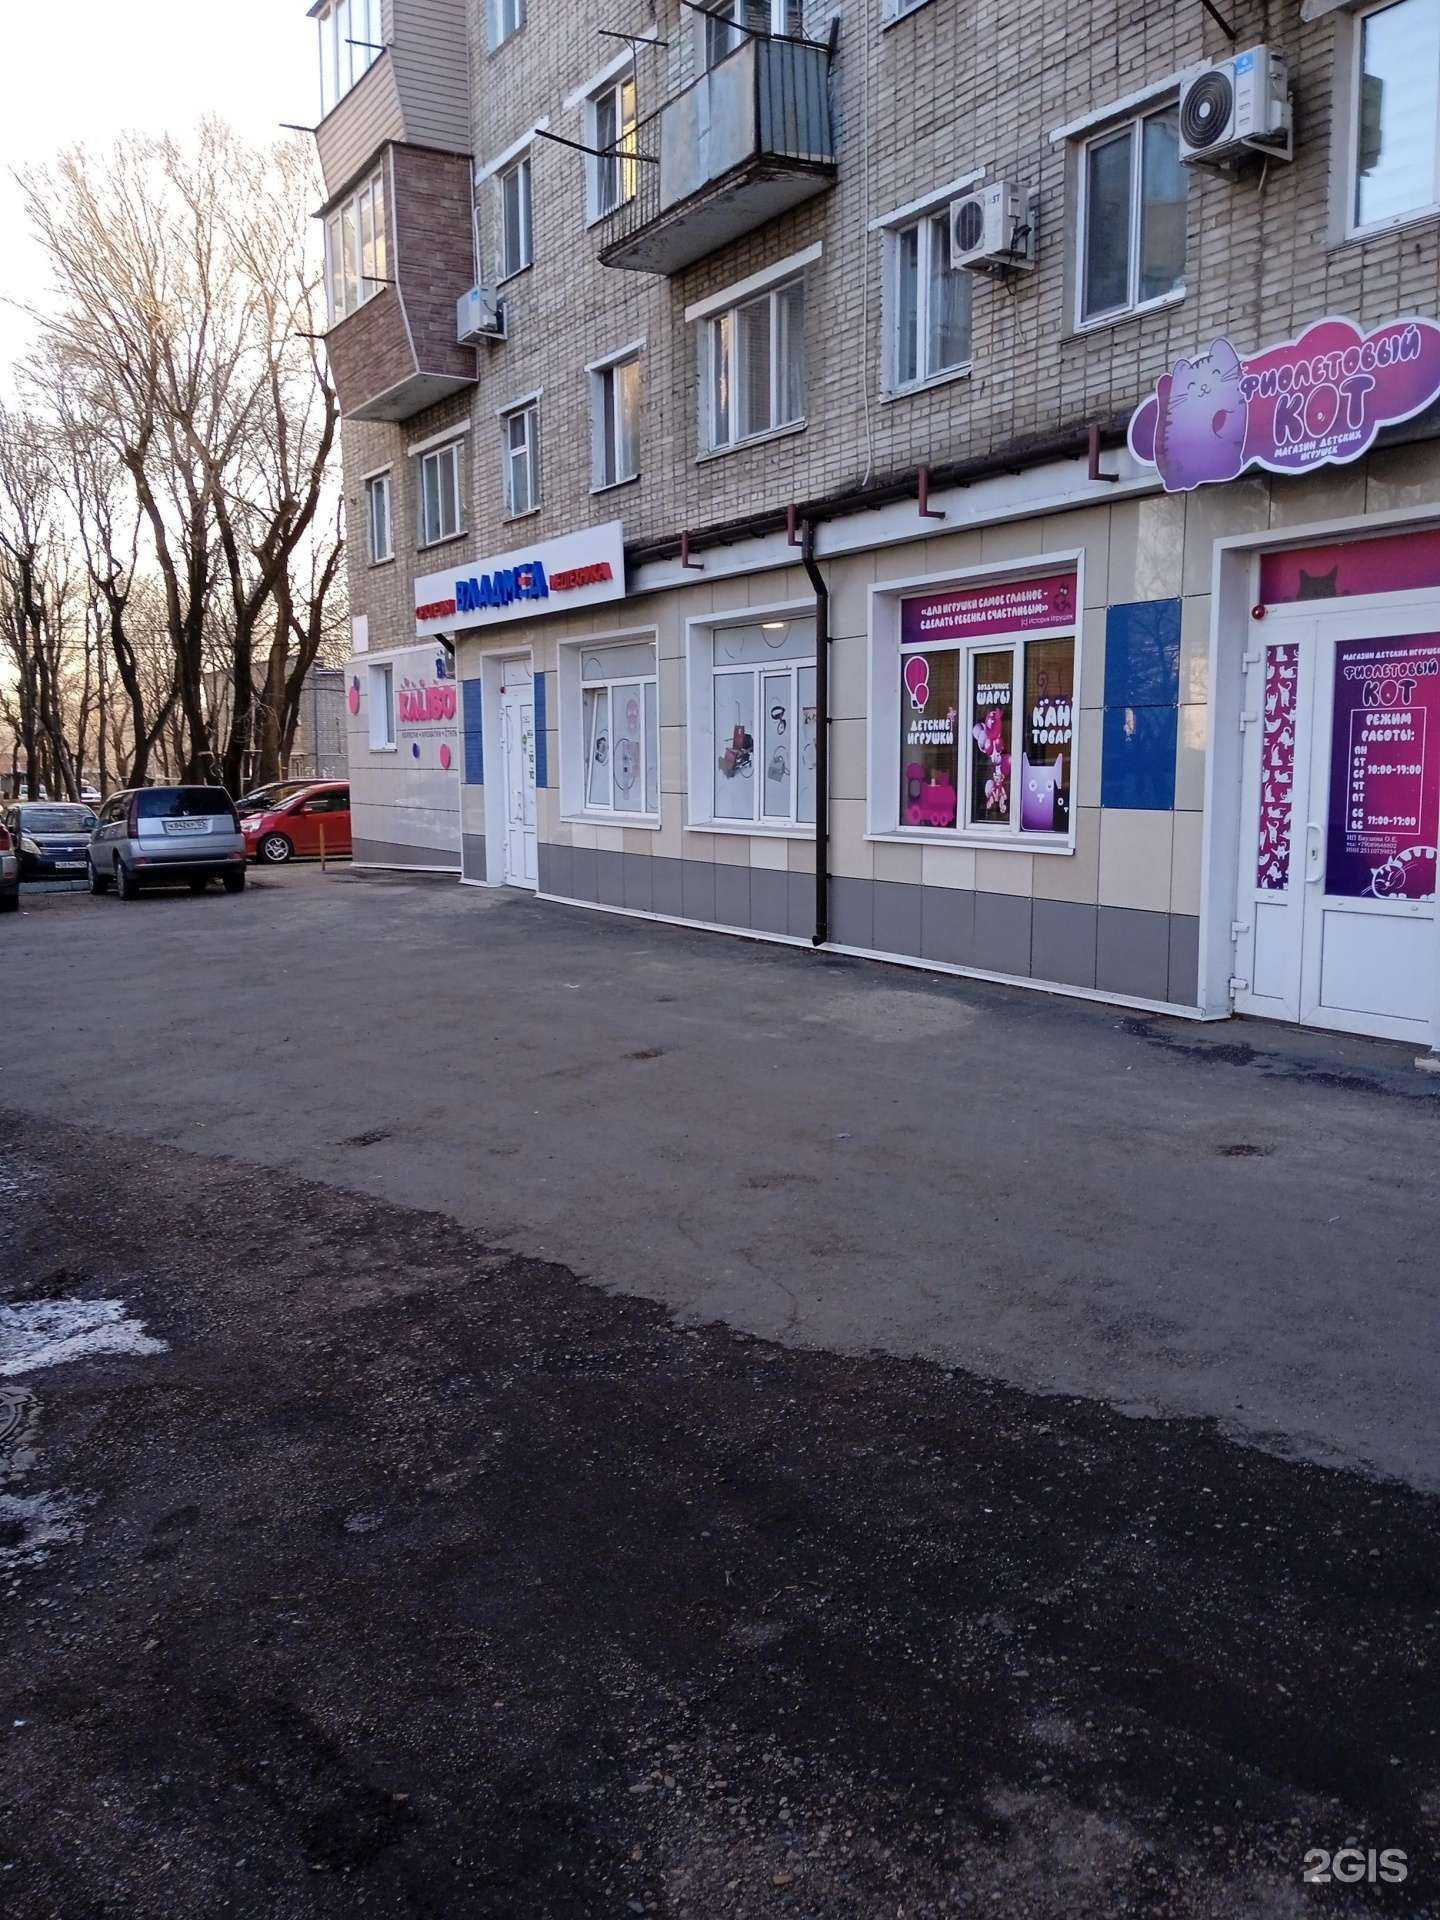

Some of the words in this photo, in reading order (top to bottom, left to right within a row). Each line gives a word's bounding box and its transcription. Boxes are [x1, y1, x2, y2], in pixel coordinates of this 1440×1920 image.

[1239, 324, 1421, 403] ФИОЛЕТОВЫЙ
[1273, 373, 1376, 447] КОТ
[1274, 442, 1317, 459] МАГАЗИН
[1319, 429, 1362, 449] ДЕТСКИХ
[978, 592, 1006, 607] САМОЕ
[920, 619, 954, 631] СДЕЛАТЬ
[1342, 652, 1375, 661] МАГАЗИН
[1375, 649, 1409, 659] ДЕТСКИХ
[1344, 658, 1438, 680] ФИОЛЕТОВЫЙ
[977, 690, 1010, 704] ШАРЫ
[1363, 679, 1417, 706] КОТ
[911, 719, 951, 731] ДЕТСКИЕ
[1366, 712, 1412, 726] РЕЖИМ
[907, 731, 954, 745] ИГРУШКИ
[1361, 728, 1415, 742] РАБОТЫ:
[1354, 745, 1368, 755] ПН
[1352, 769, 1365, 779] СР
[1352, 781, 1365, 791] ЧТ
